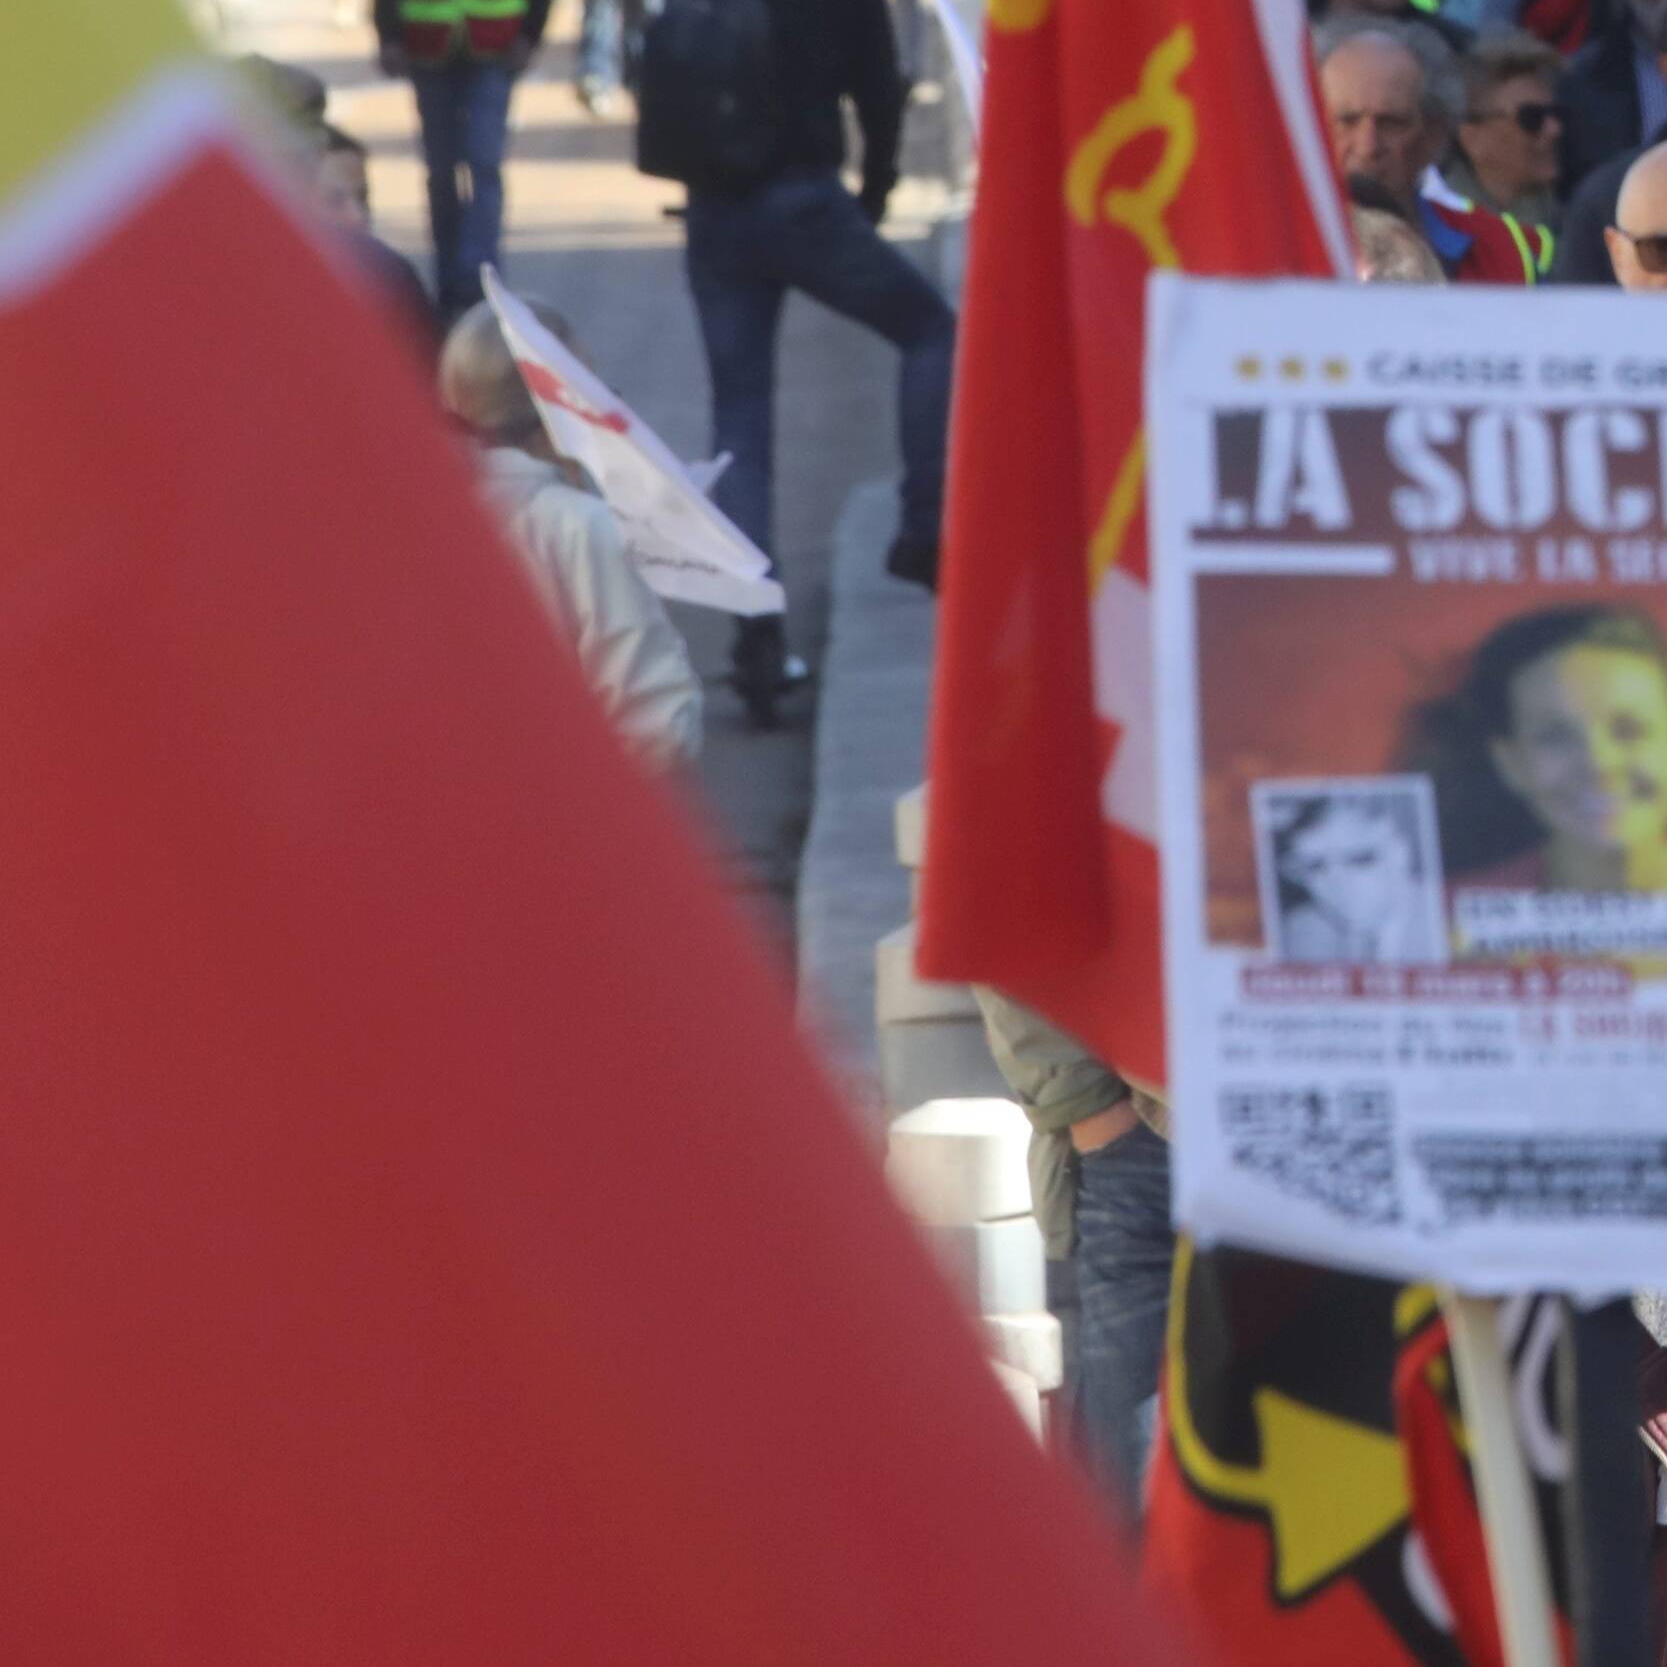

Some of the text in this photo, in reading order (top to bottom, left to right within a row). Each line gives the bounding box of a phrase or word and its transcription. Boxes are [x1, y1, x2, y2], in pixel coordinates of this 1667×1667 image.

[1366, 354, 1526, 390] CAISSE
[1538, 356, 1599, 391] DE
[1194, 408, 1352, 532] LA
[1410, 538, 1522, 585] VIVE
[1535, 539, 1600, 584] LA
